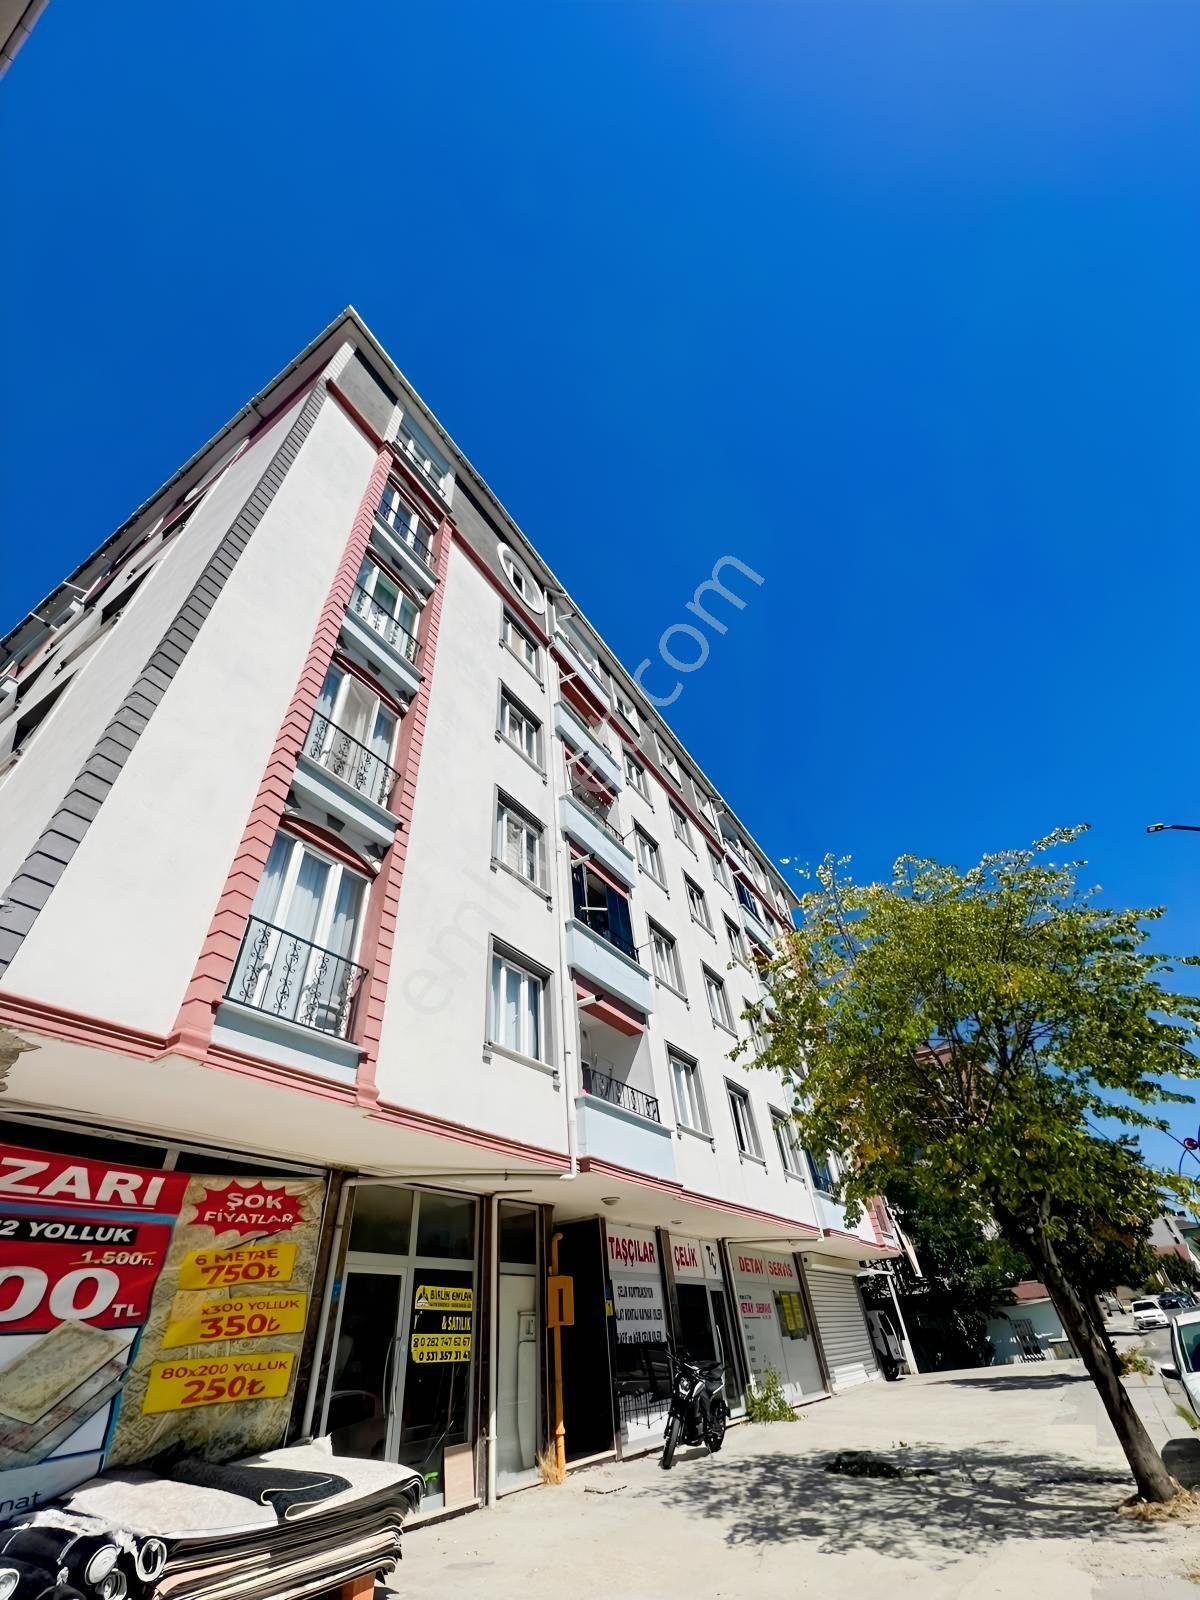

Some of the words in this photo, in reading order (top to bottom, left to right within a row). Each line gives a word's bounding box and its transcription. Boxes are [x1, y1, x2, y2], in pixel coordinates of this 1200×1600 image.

[0, 1157, 165, 1206] ZARI
[226, 1193, 284, 1210] ŞOK
[204, 1209, 294, 1224] FİYATLAR
[0, 1220, 20, 1236] 2
[29, 1222, 134, 1242] YOLLUK
[195, 1254, 207, 1265] 6
[215, 1248, 279, 1264] METRE
[608, 1236, 656, 1267] TAŞÇILAR
[674, 1243, 698, 1271] ÇELİK
[737, 1256, 764, 1275] DETAY
[112, 1303, 141, 1318] TL
[248, 1300, 300, 1310] YOLLUK
[418, 1351, 425, 1361] 0
[161, 1363, 229, 1379] 80x200
[233, 1361, 288, 1373] YOLLUK
